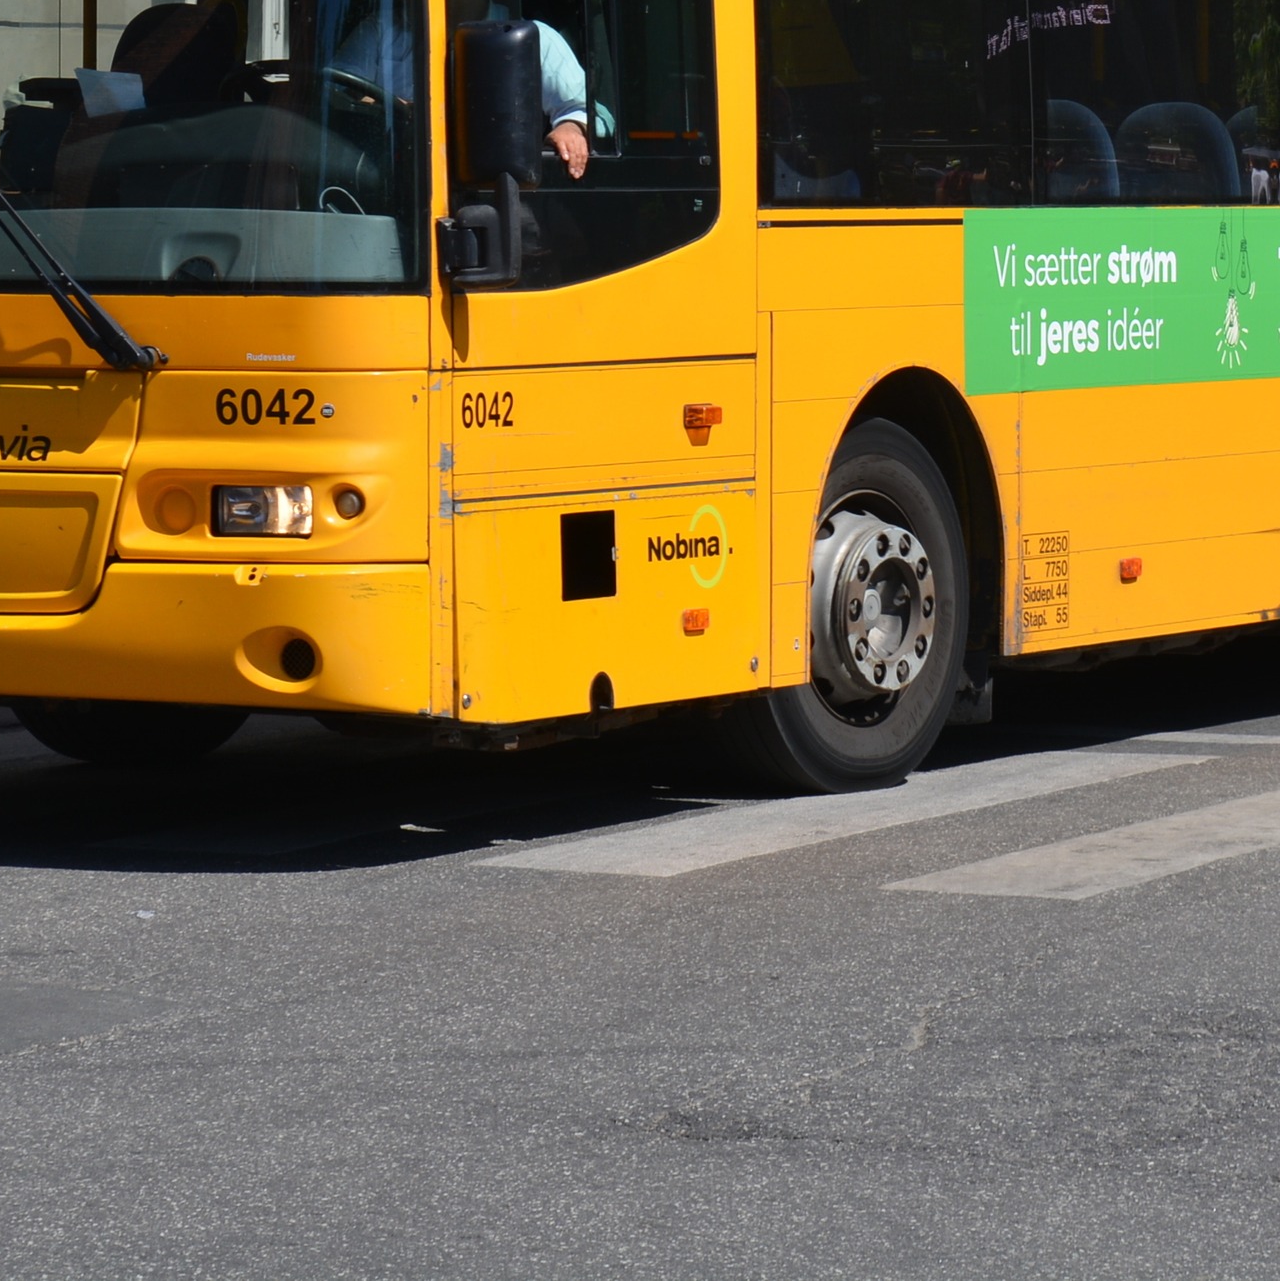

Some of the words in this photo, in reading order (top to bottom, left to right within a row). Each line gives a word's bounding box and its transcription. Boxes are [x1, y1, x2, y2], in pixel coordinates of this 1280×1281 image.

[993, 243, 1016, 287] Vi
[1024, 247, 1101, 286] sætter
[1107, 244, 1177, 287] strøm
[1010, 311, 1031, 356] til
[1037, 307, 1099, 366] jeres
[1107, 307, 1164, 351] idéer
[215, 388, 317, 425] 6042
[461, 391, 514, 429] 6042
[648, 532, 720, 562] Nobina
[1023, 539, 1030, 555] T.
[1039, 536, 1067, 554] 22250
[1045, 560, 1067, 577] 7750
[1056, 582, 1067, 599] 44
[1056, 607, 1067, 623] 55
